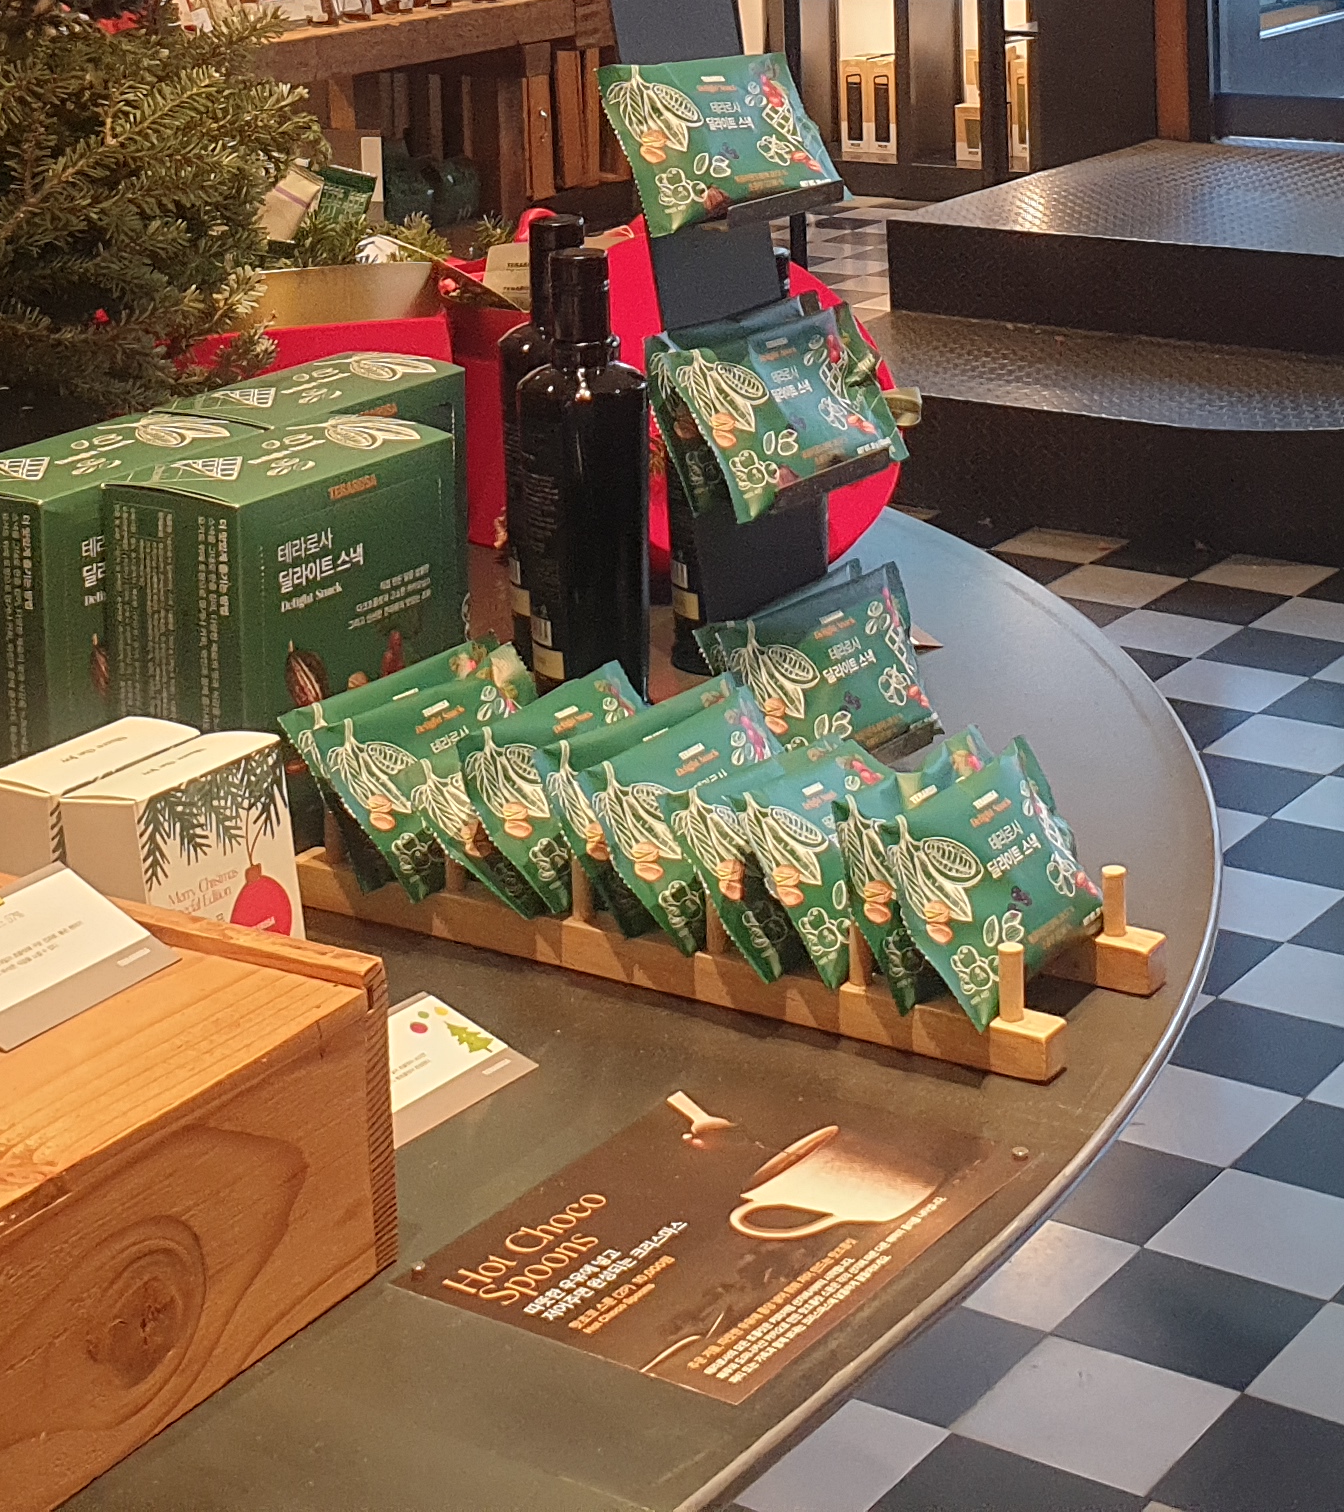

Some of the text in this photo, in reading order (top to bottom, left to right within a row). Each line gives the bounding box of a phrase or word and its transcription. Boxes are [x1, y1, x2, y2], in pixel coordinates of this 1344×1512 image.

[277, 527, 334, 564] 테라로사
[279, 542, 364, 594] 딜라이트 스낵
[822, 648, 877, 684] 딜라이트 스낵
[827, 636, 862, 660] 테라로사
[986, 832, 1042, 879] 딜라이트 스낵
[988, 819, 1024, 850] 테라로사
[169, 869, 239, 906] Merry Christmas
[442, 1193, 606, 1295] Hot Choco
[479, 1233, 599, 1306] Spoons
[523, 1287, 567, 1316] 따뜻한
[559, 1259, 600, 1290] 우유에
[541, 1220, 689, 1321] 저어주면 완성되는 크리스마스
